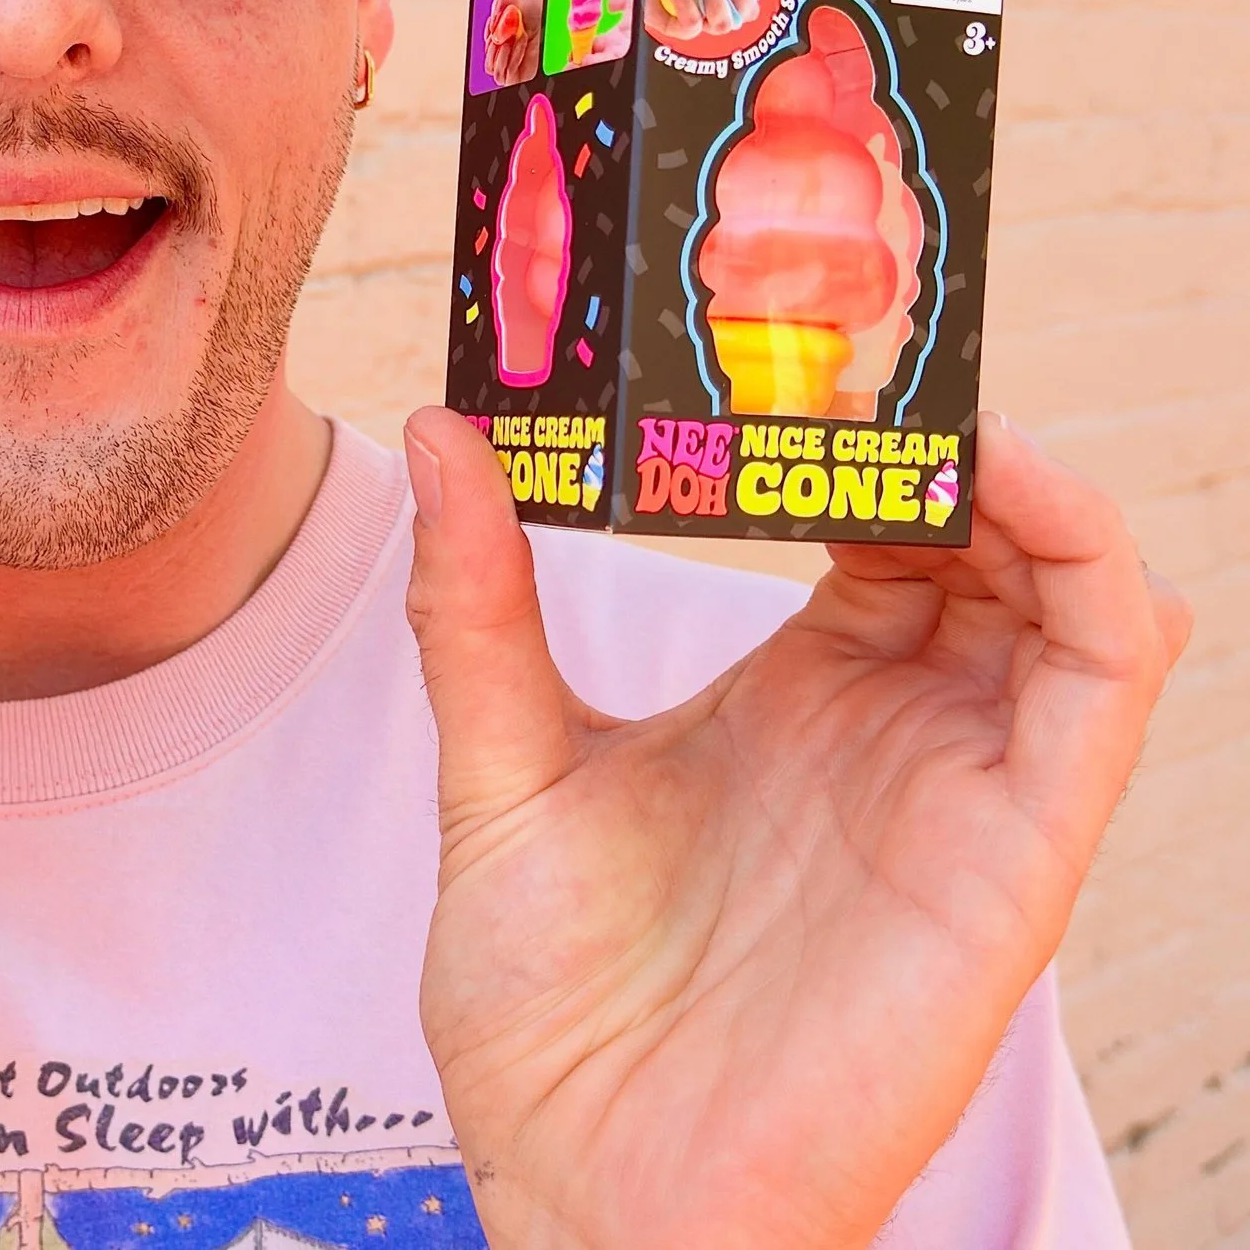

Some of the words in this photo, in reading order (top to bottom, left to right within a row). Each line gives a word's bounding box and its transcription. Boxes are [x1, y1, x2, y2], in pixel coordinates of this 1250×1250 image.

[654, 45, 729, 78] Creamy
[731, 12, 789, 70] Smooth
[963, 21, 996, 56] 3+
[492, 415, 531, 447] NICE
[534, 416, 606, 449] CREAM
[636, 418, 734, 479] NEE
[739, 424, 825, 460] NICE
[832, 429, 960, 466] CREAM
[635, 456, 730, 517] DOH
[736, 461, 921, 522] CONE
[37, 1060, 248, 1102] Outdoors
[54, 1101, 205, 1166] Sleep
